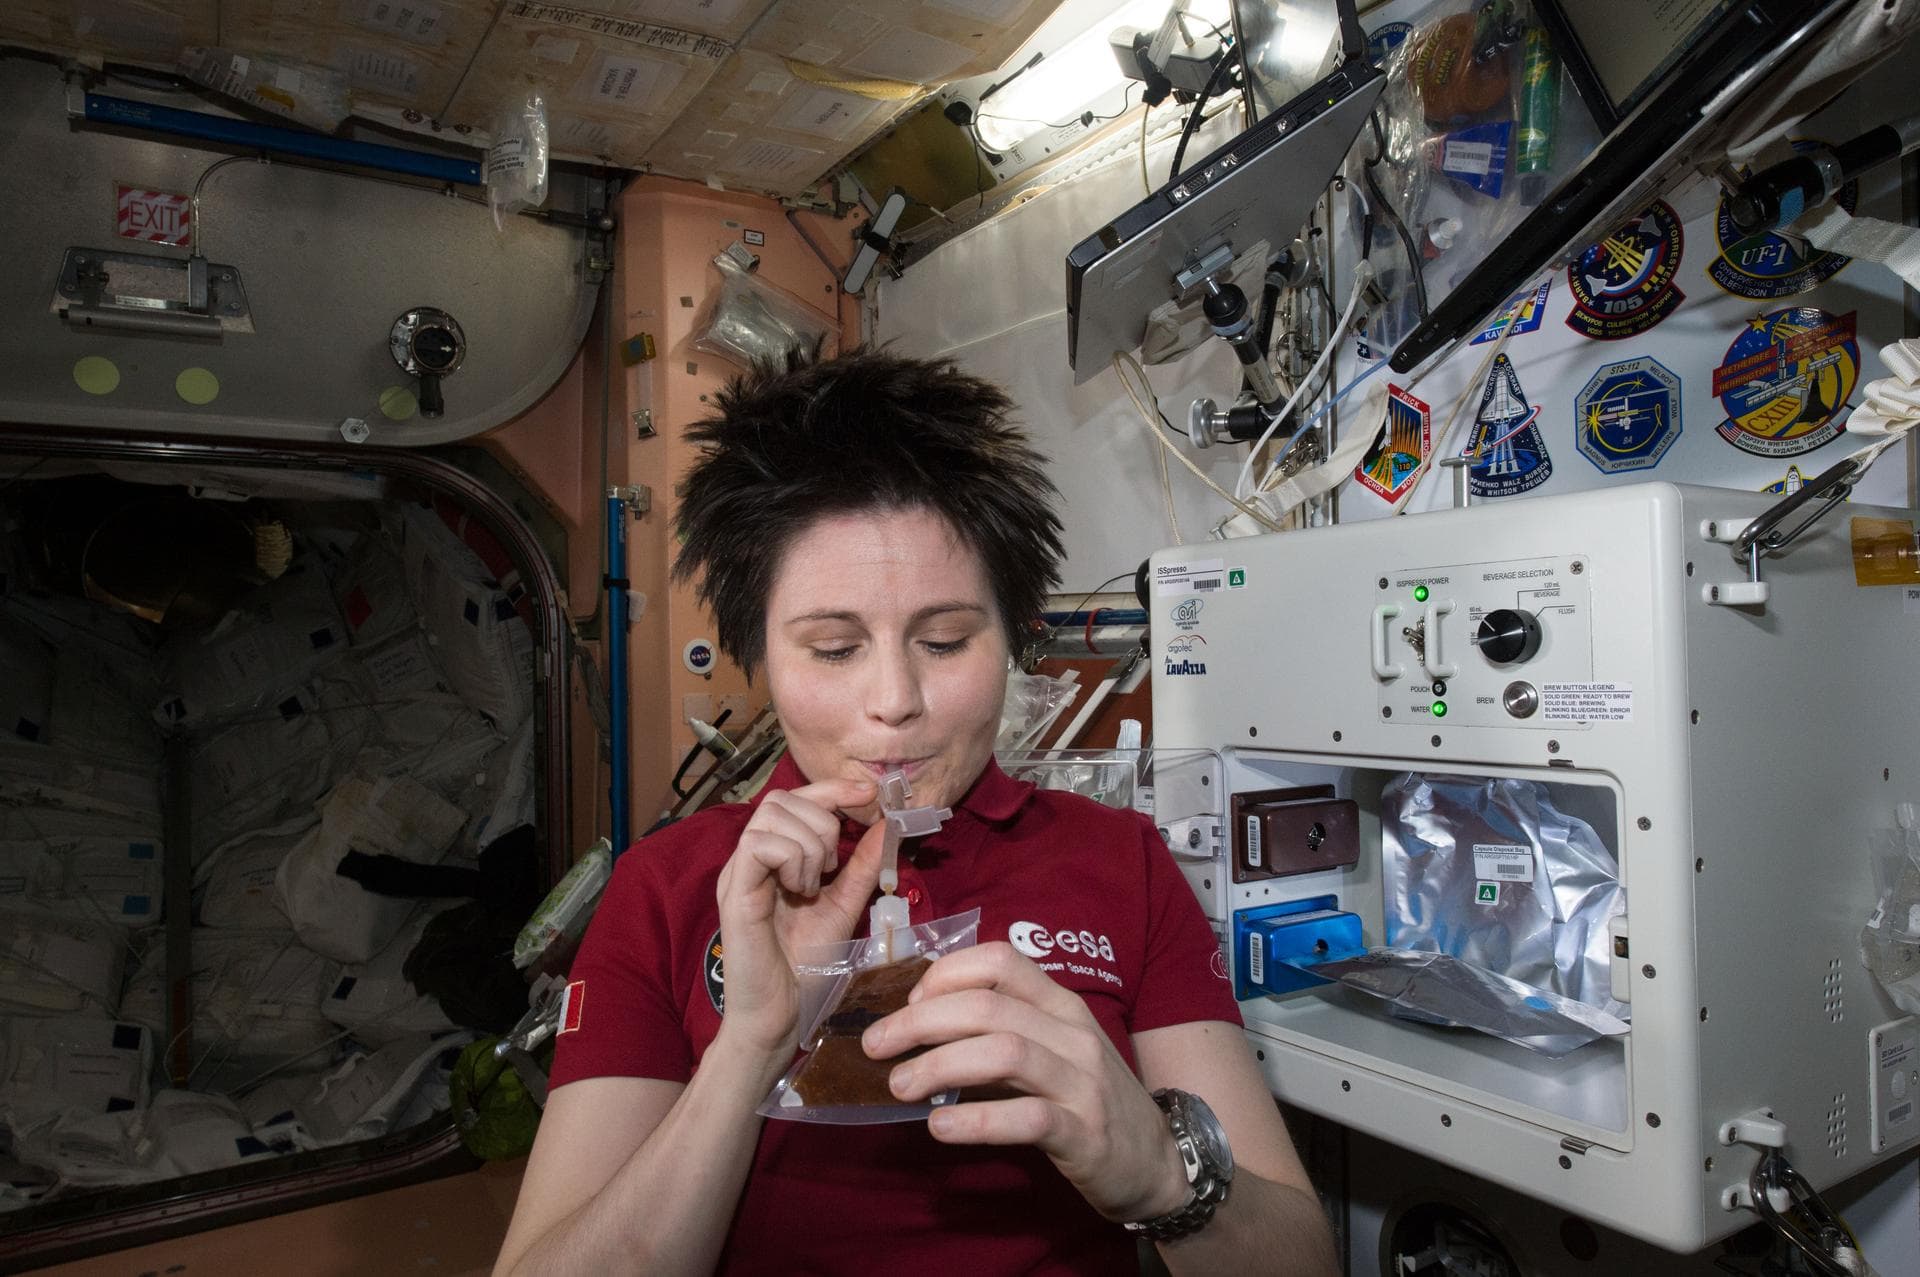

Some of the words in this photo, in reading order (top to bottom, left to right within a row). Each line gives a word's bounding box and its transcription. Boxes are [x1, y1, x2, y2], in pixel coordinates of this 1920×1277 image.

[130, 200, 178, 231] EXIT
[1660, 224, 1679, 286] FORRESTER
[1741, 242, 1788, 266] UF-1
[1571, 275, 1590, 303] BARRY
[1604, 295, 1644, 314] 105
[1485, 324, 1522, 340] KAVDI
[1610, 362, 1640, 374] STS-112
[1649, 366, 1674, 385] MELROY
[1484, 365, 1499, 400] COCKRELL
[1504, 362, 1521, 395] LOCKHART
[1584, 377, 1603, 398] ASHBY
[1399, 392, 1419, 408] FRICK
[1469, 424, 1480, 448] PERRIN
[1651, 432, 1674, 459] SELLERS
[1737, 438, 1770, 454] BOWERSOX
[1773, 445, 1804, 454] БУДАРИН
[1584, 446, 1606, 466] MAGNUS
[1487, 459, 1520, 476] 111
[1525, 462, 1549, 481] BURSCH
[1364, 478, 1384, 494] OCHOA
[1488, 488, 1517, 496] WHITSON
[1158, 566, 1187, 574] ISSpresso
[1483, 572, 1516, 581] BEVERAGE
[1518, 569, 1554, 578] SELECTION
[1428, 577, 1449, 585] POWER
[1168, 644, 1192, 653] argotec
[1166, 660, 1206, 675] LAVAZZA
[1056, 930, 1116, 962] esa
[1067, 962, 1096, 976] Space
[1098, 968, 1122, 987] Agency
